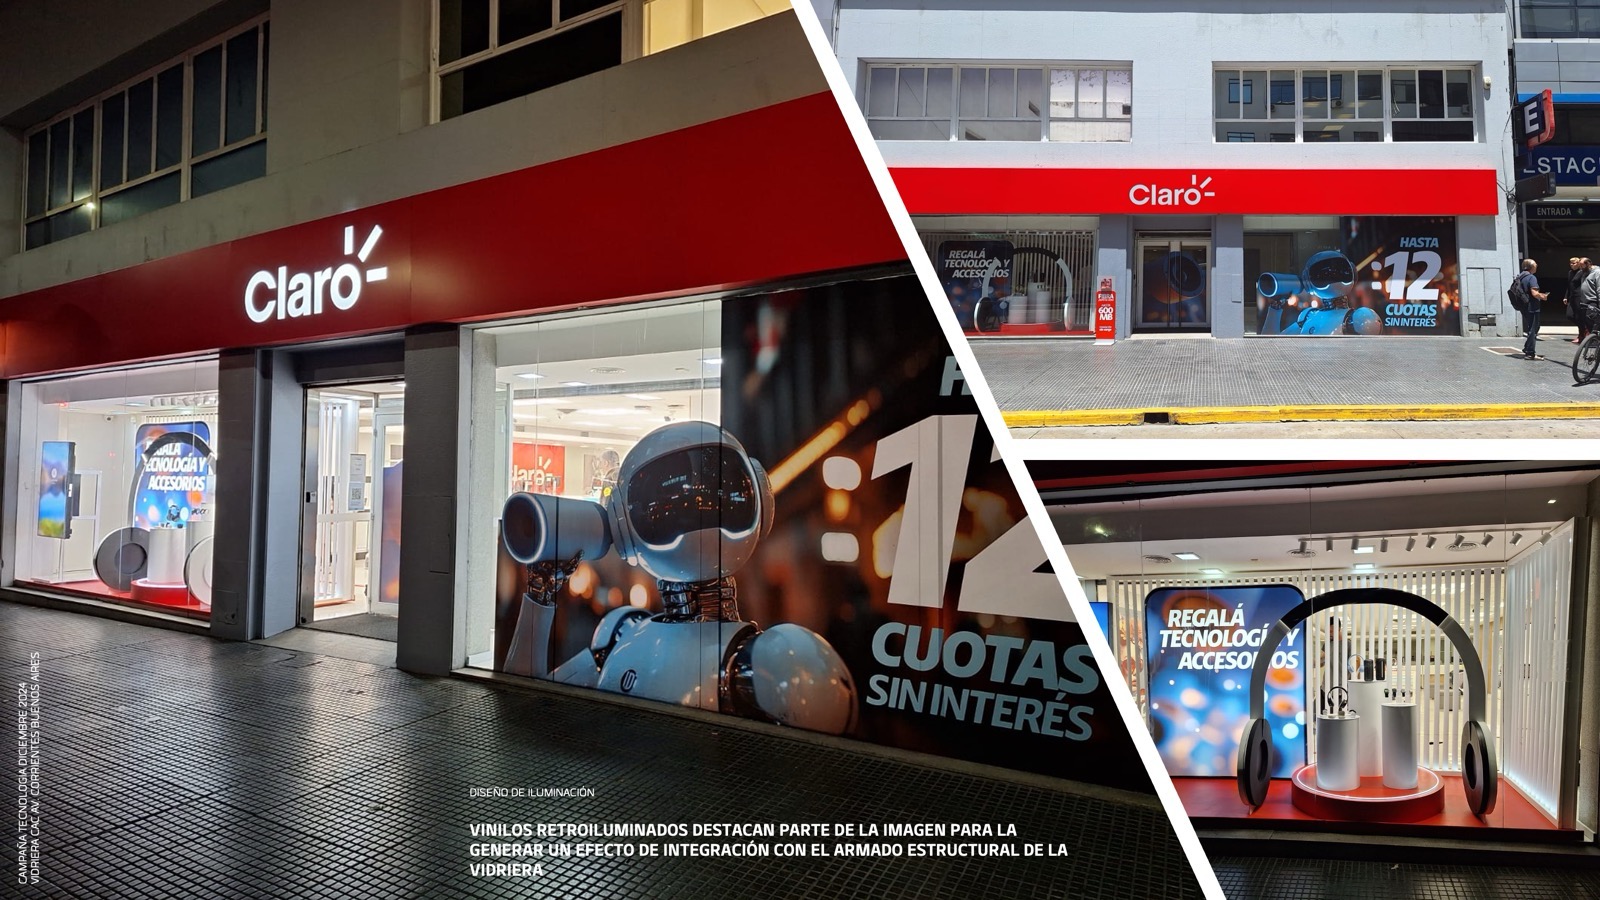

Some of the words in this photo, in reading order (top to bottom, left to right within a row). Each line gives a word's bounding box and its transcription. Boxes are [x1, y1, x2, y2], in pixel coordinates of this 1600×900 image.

[1524, 101, 1539, 134] E
[1524, 157, 1600, 174] STAC
[1129, 184, 1201, 206] Claro
[1537, 208, 1571, 216] ENTRADA
[1400, 237, 1439, 248] HASTA
[949, 248, 986, 259] REGALÁ
[945, 259, 1001, 268] TECNOLOG
[1004, 259, 1010, 267] Y
[952, 269, 1009, 278] ACCESOIOS
[245, 264, 361, 323] Claro
[1385, 303, 1437, 316] CUOTAS
[1385, 318, 1400, 327] SIN
[1401, 316, 1436, 327] INTERÉS
[146, 453, 197, 473] ECNOLOGÍA
[198, 457, 207, 473] Y
[148, 475, 206, 491] ACCESORIOS
[512, 465, 545, 486] laro
[1168, 603, 1245, 628] REGALÁ
[1160, 623, 1277, 648] TECNOLOGÍ
[1286, 628, 1300, 647] Y
[872, 622, 1099, 694] CUOTAS
[1178, 651, 1299, 670] ACCESOOS
[866, 674, 927, 713] SIN
[930, 684, 1094, 741] INTERÉS
